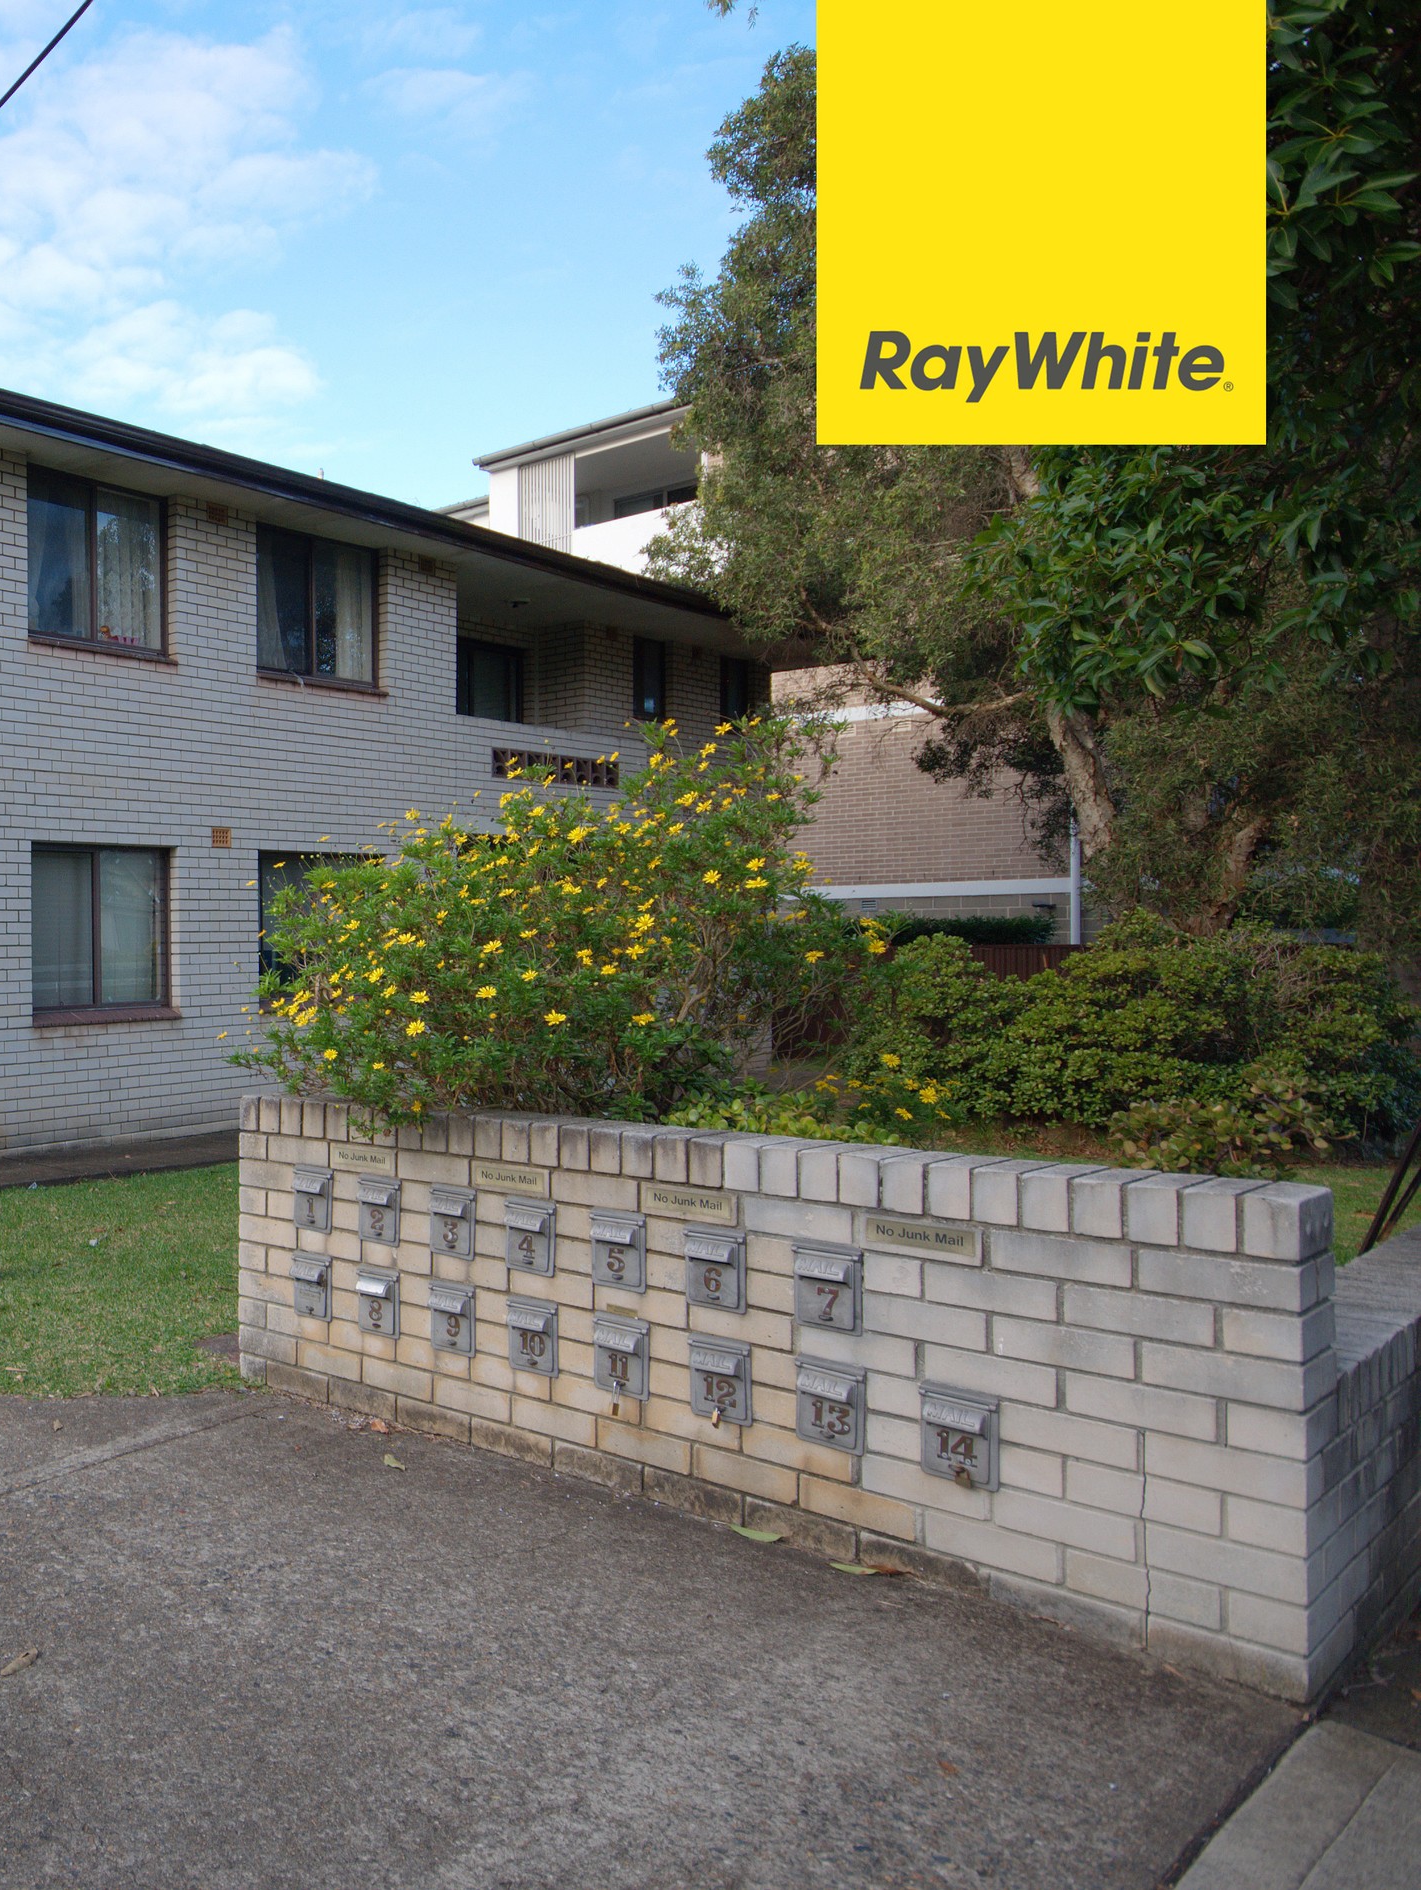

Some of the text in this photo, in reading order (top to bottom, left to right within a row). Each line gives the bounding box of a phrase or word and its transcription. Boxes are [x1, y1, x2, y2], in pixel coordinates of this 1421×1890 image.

[338, 1151, 386, 1165] No Junk Mail
[481, 1170, 537, 1185] No Junk Mail
[306, 1197, 315, 1219] 1
[653, 1192, 723, 1211] No Junk Mail
[370, 1208, 385, 1231] 2
[442, 1220, 459, 1244] 3
[875, 1223, 964, 1247] No Junk Mail
[518, 1234, 536, 1260] 4
[686, 1239, 725, 1257] MAIL
[606, 1247, 626, 1274] 5
[797, 1256, 840, 1276] MAIL
[703, 1266, 722, 1293] 6
[368, 1299, 383, 1321] 8
[816, 1286, 840, 1316] 7
[446, 1314, 461, 1338] 9
[519, 1331, 546, 1358] 10
[595, 1329, 631, 1349] MAIL
[608, 1353, 630, 1382] 11
[692, 1350, 731, 1370] MAIL
[703, 1375, 737, 1409] 12
[801, 1373, 842, 1397] MAIL
[811, 1400, 851, 1436] 13
[926, 1402, 976, 1428] MAIL
[936, 1429, 978, 1468] 14
